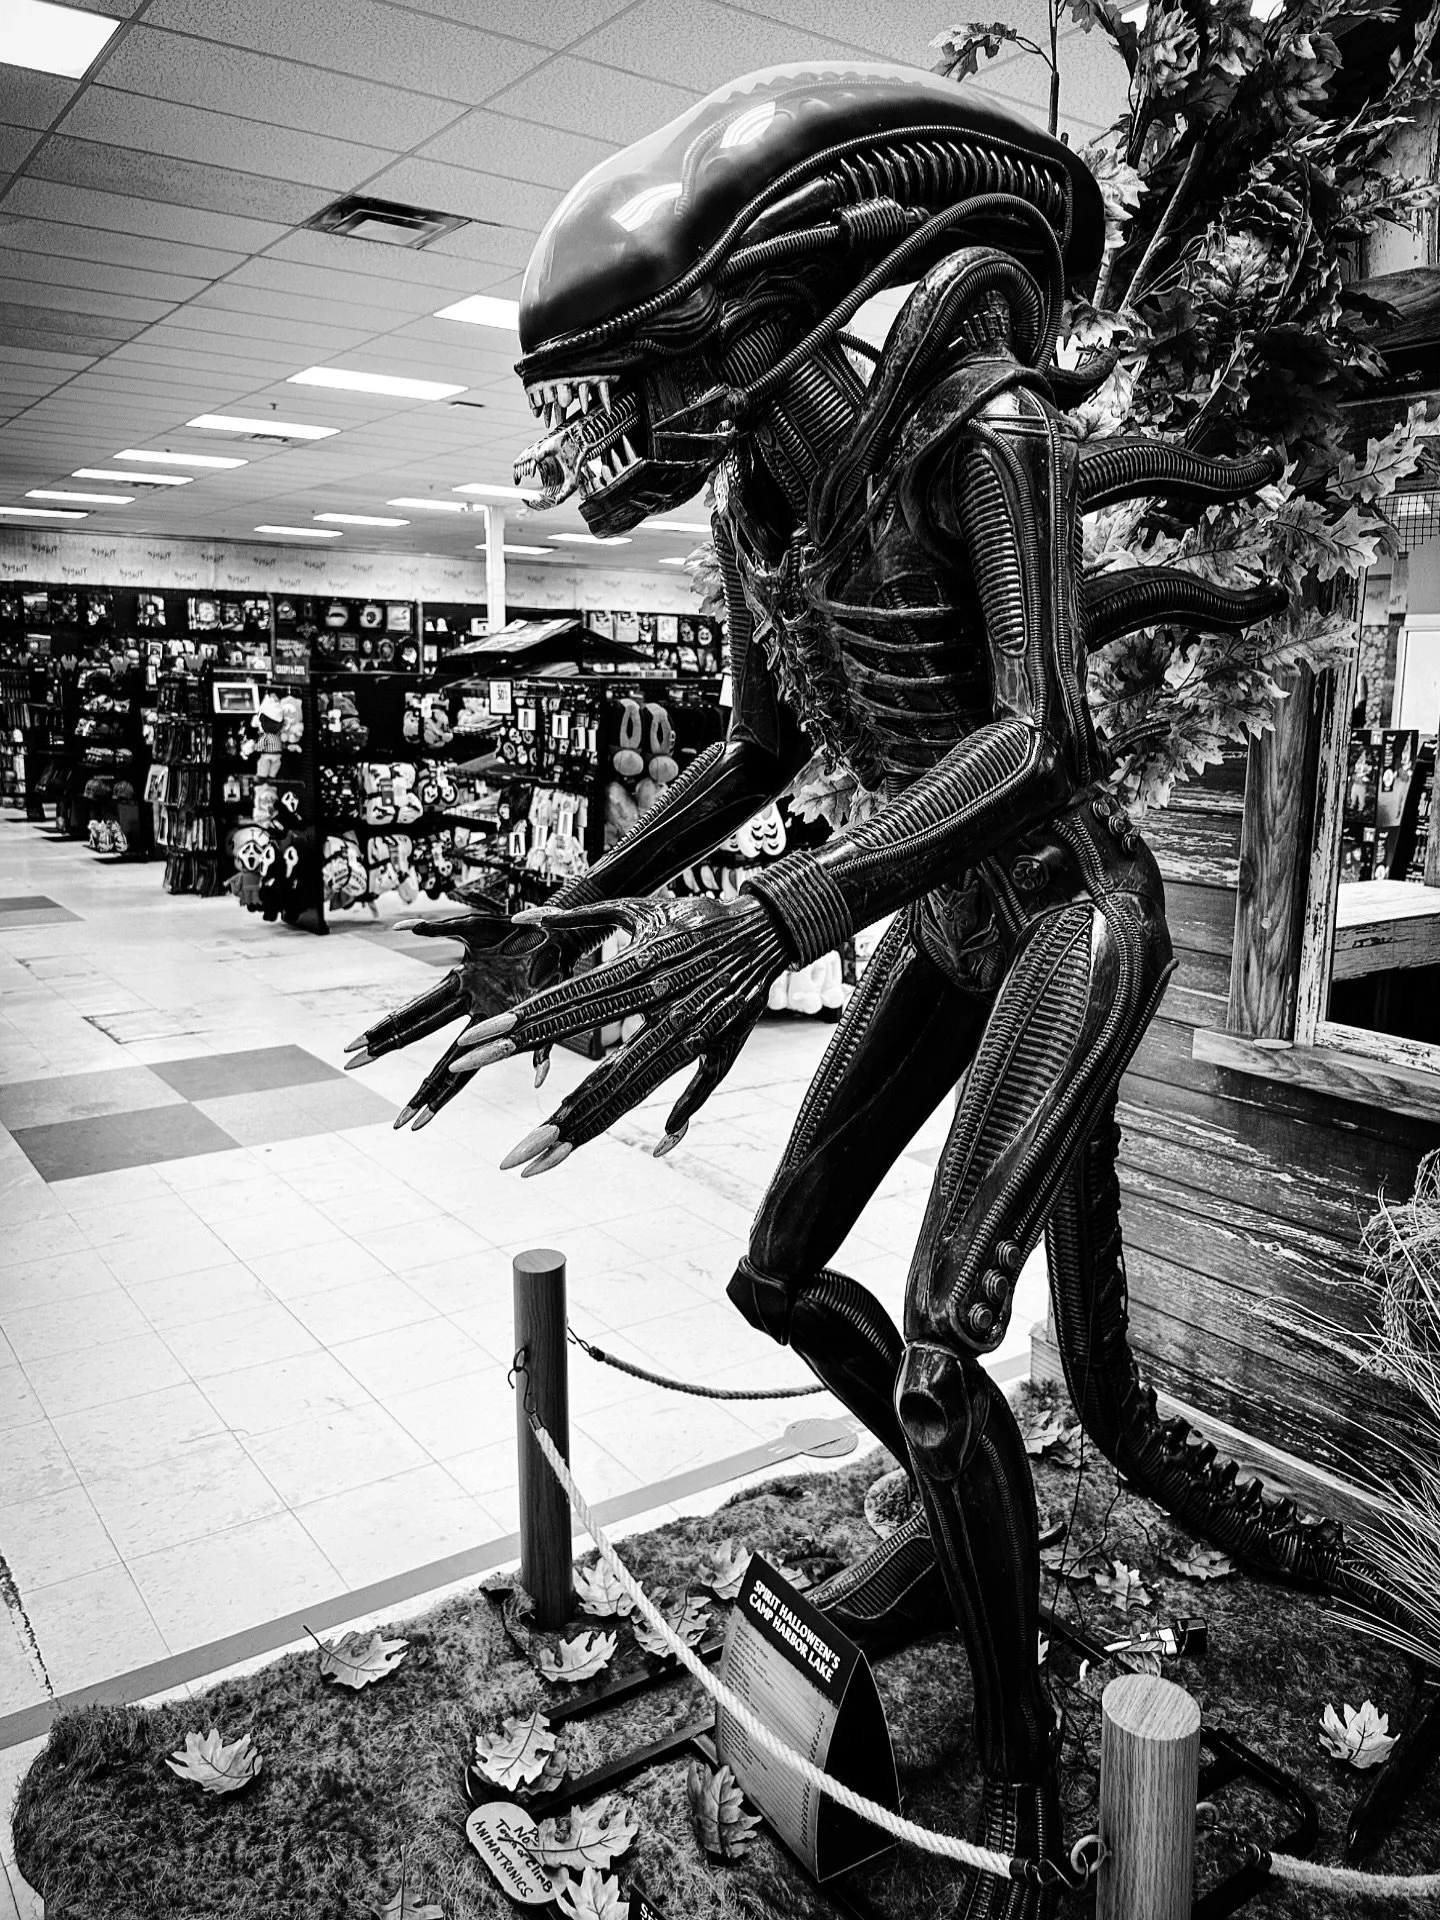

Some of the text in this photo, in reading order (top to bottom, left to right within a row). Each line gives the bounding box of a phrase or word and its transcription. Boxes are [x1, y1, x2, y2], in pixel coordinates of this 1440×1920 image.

[749, 1593, 774, 1621] CAMP
[772, 1615, 808, 1658] HARBOR
[807, 1650, 834, 1683] LAKE
[753, 1580, 840, 1669] SPIRIT HALLOWEEN'S
[472, 1820, 534, 1897] ANIMATRONICS
